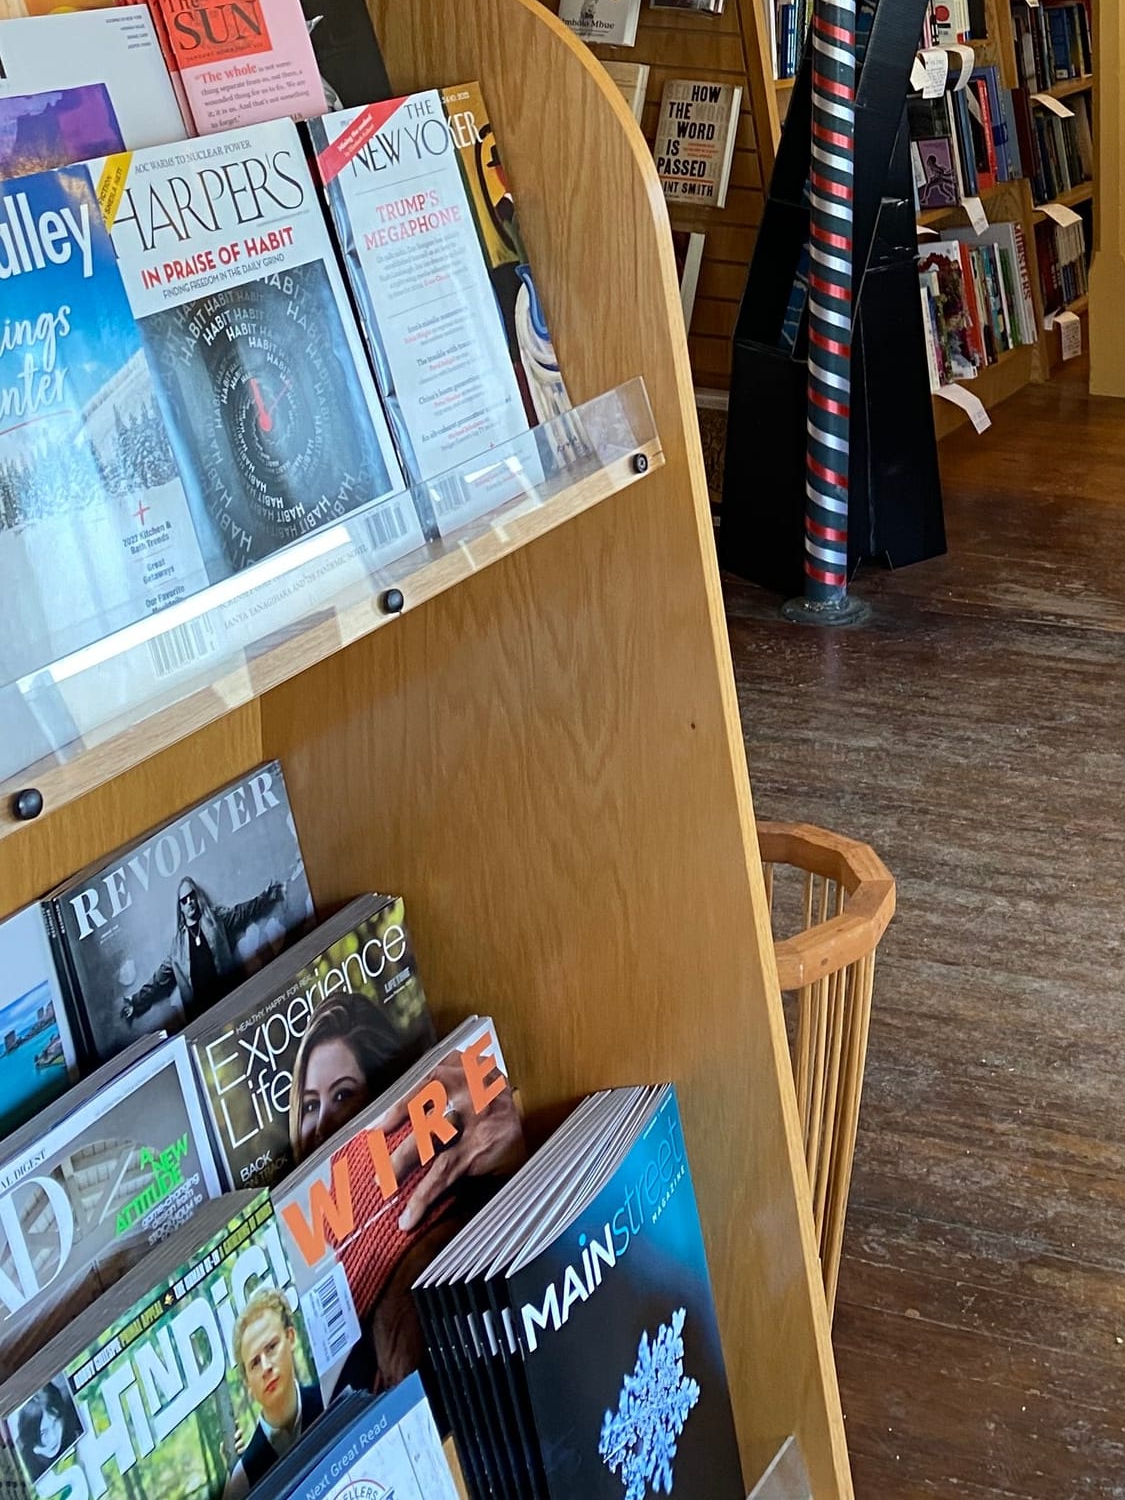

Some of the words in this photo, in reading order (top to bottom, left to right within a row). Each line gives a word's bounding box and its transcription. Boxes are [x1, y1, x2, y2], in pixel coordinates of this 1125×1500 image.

[590, 19, 615, 31] Mbue
[224, 63, 258, 81] whole
[203, 94, 234, 107] wounded
[219, 81, 246, 94] separate
[691, 85, 722, 104] HOW
[404, 99, 435, 120] THE
[668, 102, 692, 120] THE
[676, 121, 715, 141] WORD
[175, 154, 186, 166] TO
[186, 147, 223, 164] NUCLEAR
[222, 140, 252, 155] POWER
[351, 126, 402, 178] NEW
[666, 138, 680, 157] IS
[657, 157, 706, 178] PASSED
[681, 182, 714, 197] SMITH
[110, 150, 304, 259] HARPER'S
[376, 189, 440, 223] TRUMP'S
[0, 192, 94, 279] alley
[362, 204, 463, 251] MEGAPHONE
[141, 266, 162, 290] IN
[162, 250, 217, 283] PRAISE
[218, 242, 242, 263] OF
[243, 226, 294, 257] HABIT
[162, 282, 191, 299] FINDING
[190, 274, 220, 293] FREEDOM
[219, 272, 228, 283] IN
[227, 267, 242, 280] THE
[242, 260, 262, 277] DAILY
[262, 253, 285, 268] GRIND
[202, 309, 233, 347] HABIT
[226, 322, 257, 342] HABIT
[248, 336, 278, 353] HABIT
[266, 351, 292, 374] HABIT
[122, 533, 139, 548] 2022
[139, 524, 164, 543] Kitchen
[165, 520, 173, 529] &
[129, 540, 147, 555] Bath
[146, 533, 170, 549] Trends
[142, 565, 177, 585] Getaways
[146, 557, 167, 571] Great
[144, 594, 158, 608] Our
[157, 584, 186, 604] Favorite
[68, 771, 282, 943] REVOLVER
[205, 924, 407, 1095] Experience
[220, 1067, 294, 1150] Life
[140, 1146, 154, 1171] A
[152, 1132, 190, 1179] NEW
[282, 1031, 506, 1269] WIRE
[13, 1147, 47, 1181] DIGEST
[240, 1149, 274, 1183] BACK
[115, 1167, 186, 1237] ATTITUDE
[141, 1172, 200, 1230] game-changing
[177, 1188, 195, 1207] from
[651, 1164, 687, 1226] MAGAZINE
[304, 1473, 331, 1500] Next
[329, 1443, 360, 1478] Great
[359, 1413, 389, 1449] Read
